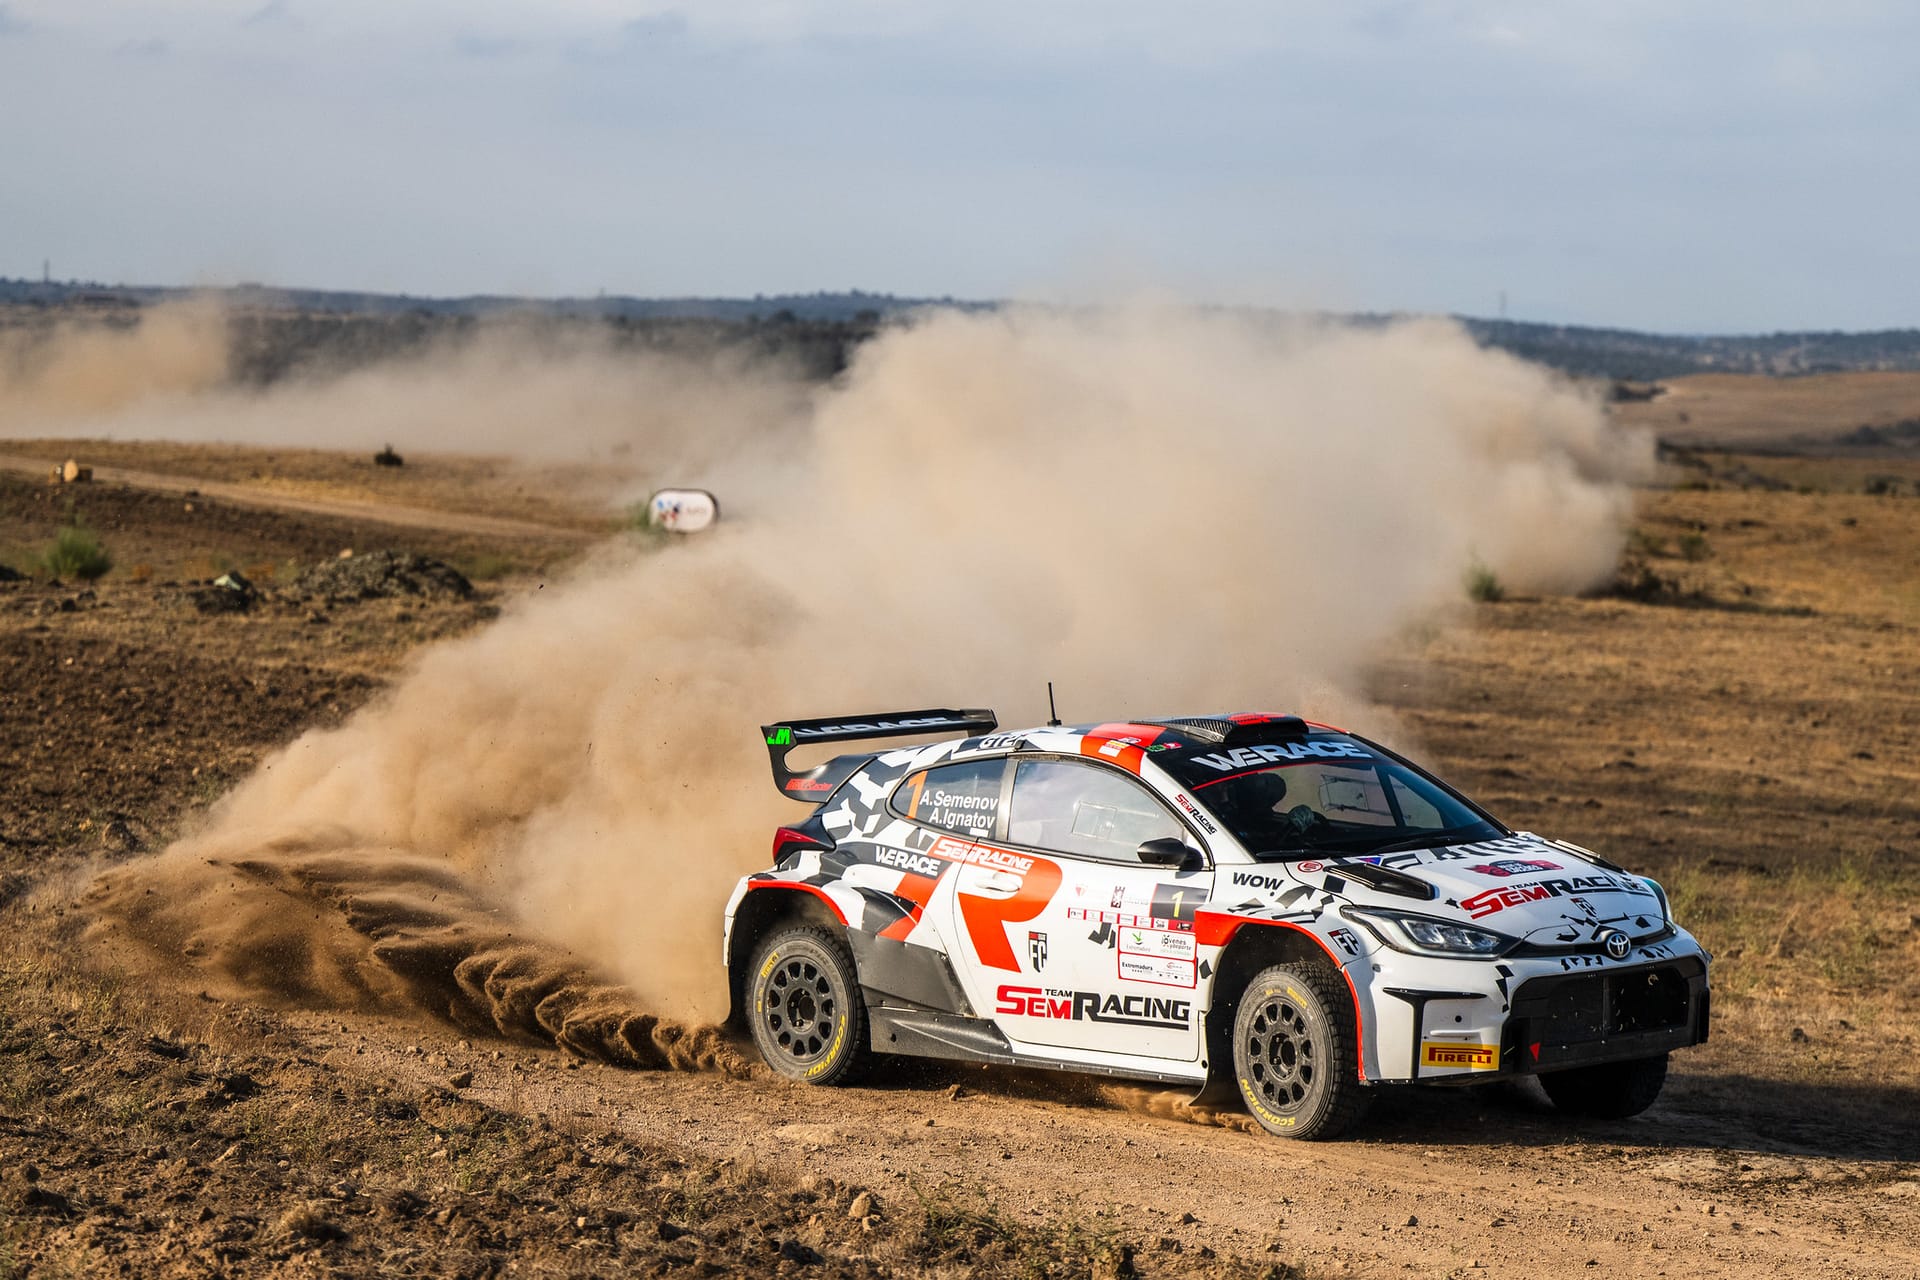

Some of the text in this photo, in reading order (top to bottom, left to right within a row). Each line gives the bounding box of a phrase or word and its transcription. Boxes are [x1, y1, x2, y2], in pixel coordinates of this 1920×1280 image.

[1190, 741, 1373, 772] WERACE
[919, 790, 998, 811] A.Semenov
[928, 807, 995, 829] A.Ignatov
[874, 845, 942, 876] WERACE
[1509, 881, 1539, 890] TEAM
[1171, 890, 1185, 918] 1
[1121, 961, 1153, 971] Extremadura
[1044, 988, 1072, 998] TEAM
[1428, 1046, 1493, 1064] PIRELLI
[1239, 1078, 1297, 1127] SCORPION
